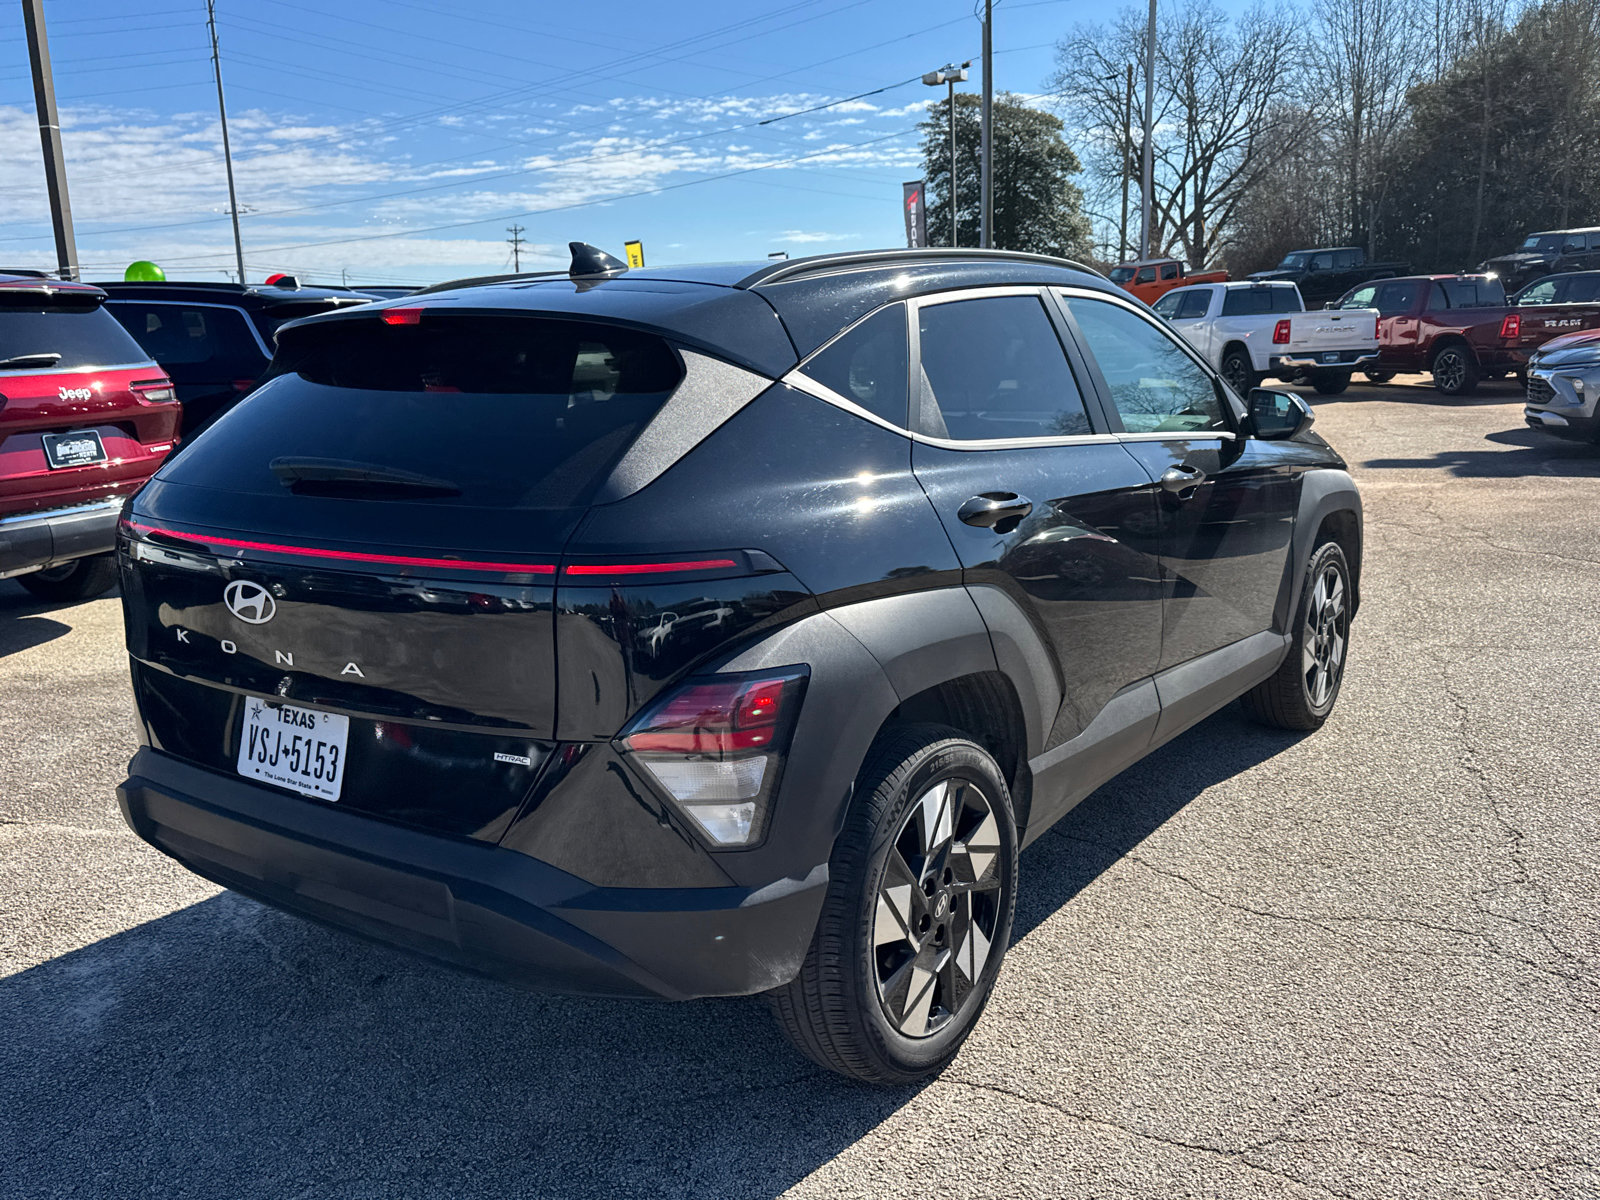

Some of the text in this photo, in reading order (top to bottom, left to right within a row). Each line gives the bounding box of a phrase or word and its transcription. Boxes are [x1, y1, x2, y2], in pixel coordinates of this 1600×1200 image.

[1544, 319, 1582, 328] RAM
[59, 387, 91, 401] Jeep
[176, 628, 365, 678] KONA
[276, 707, 315, 730] TEXAS
[248, 724, 339, 783] VSJ 5153
[496, 754, 528, 764] HTRAC
[264, 771, 312, 790] The Lone Star State
